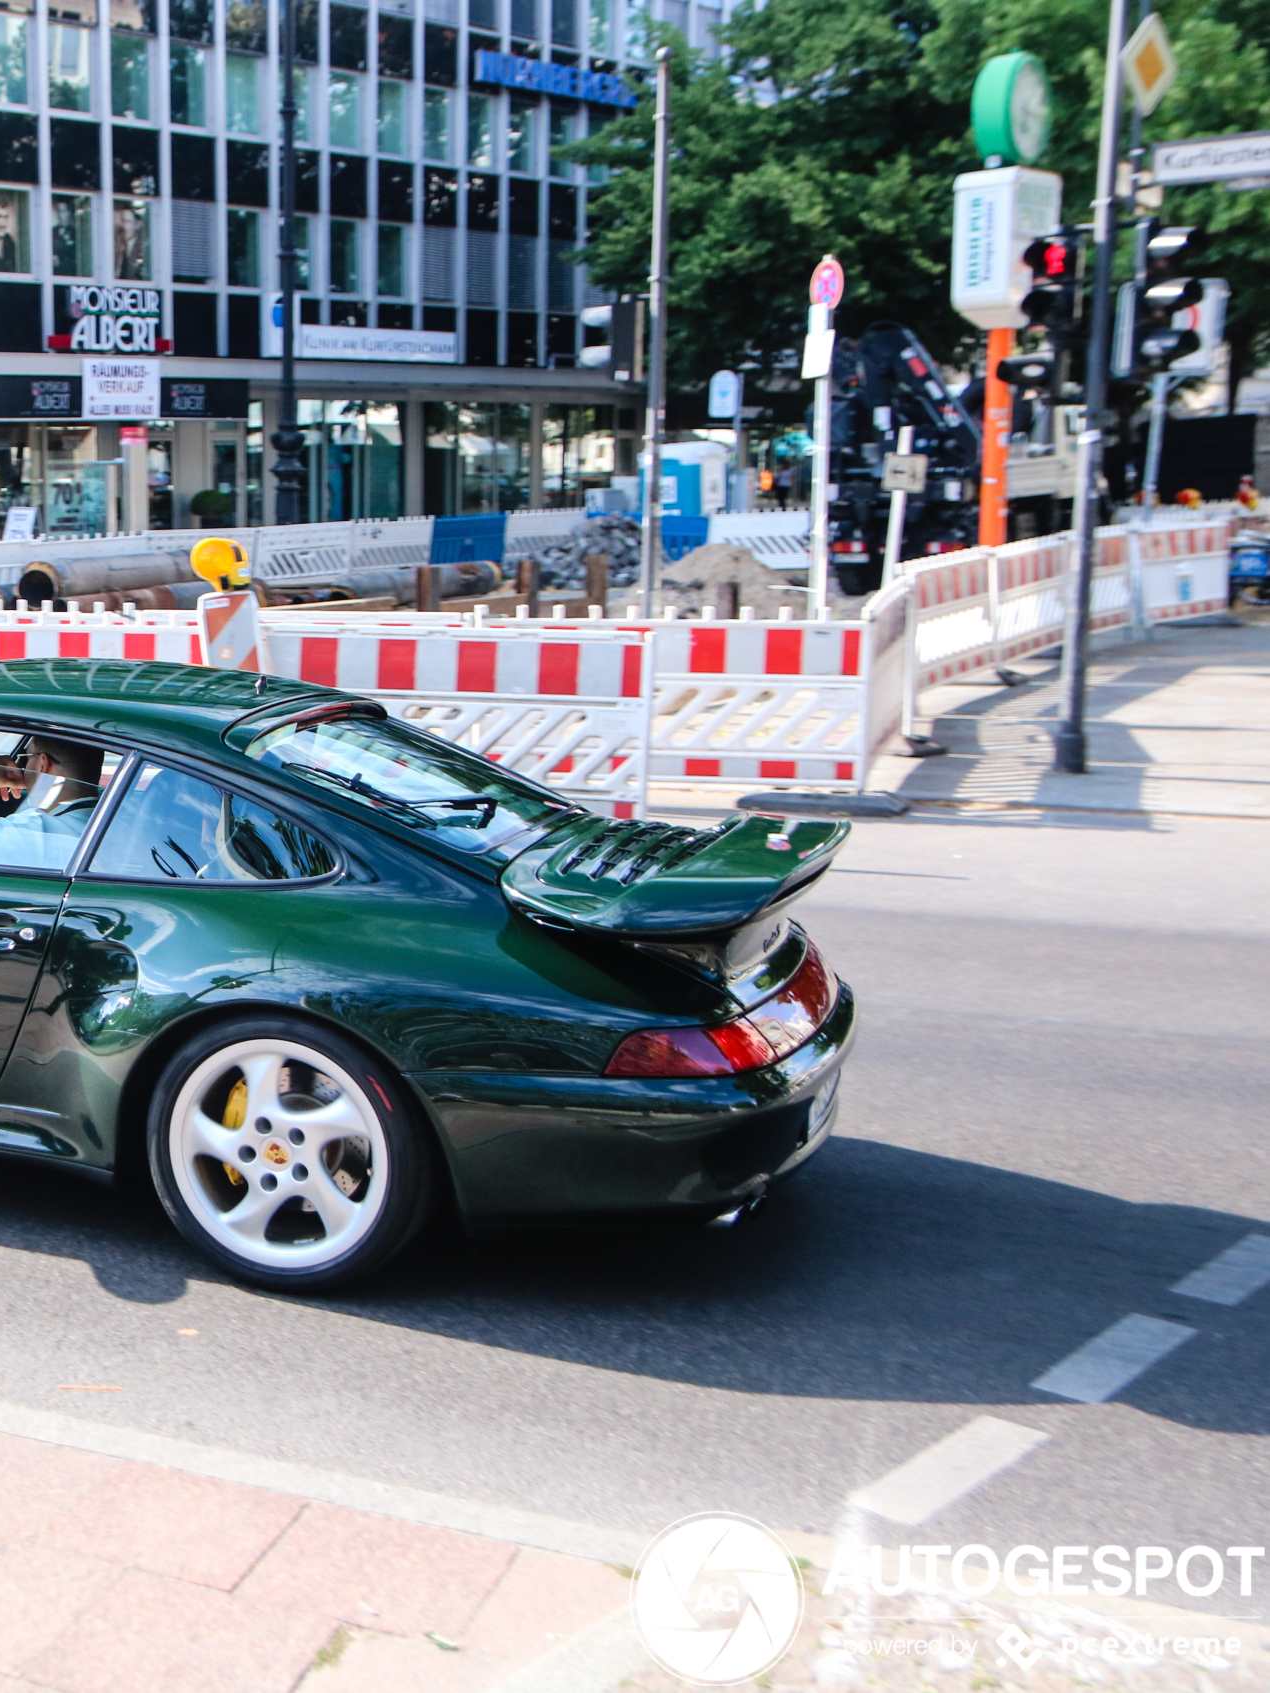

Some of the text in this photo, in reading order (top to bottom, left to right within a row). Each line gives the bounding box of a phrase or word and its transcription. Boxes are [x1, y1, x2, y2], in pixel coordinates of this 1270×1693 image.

[967, 196, 983, 287] IRISH PUB
[70, 285, 160, 313] MONSIEUR
[70, 314, 160, 352] ALBERT
[90, 362, 150, 378] RÄUMUNGS-
[98, 380, 144, 394] VERKAUF
